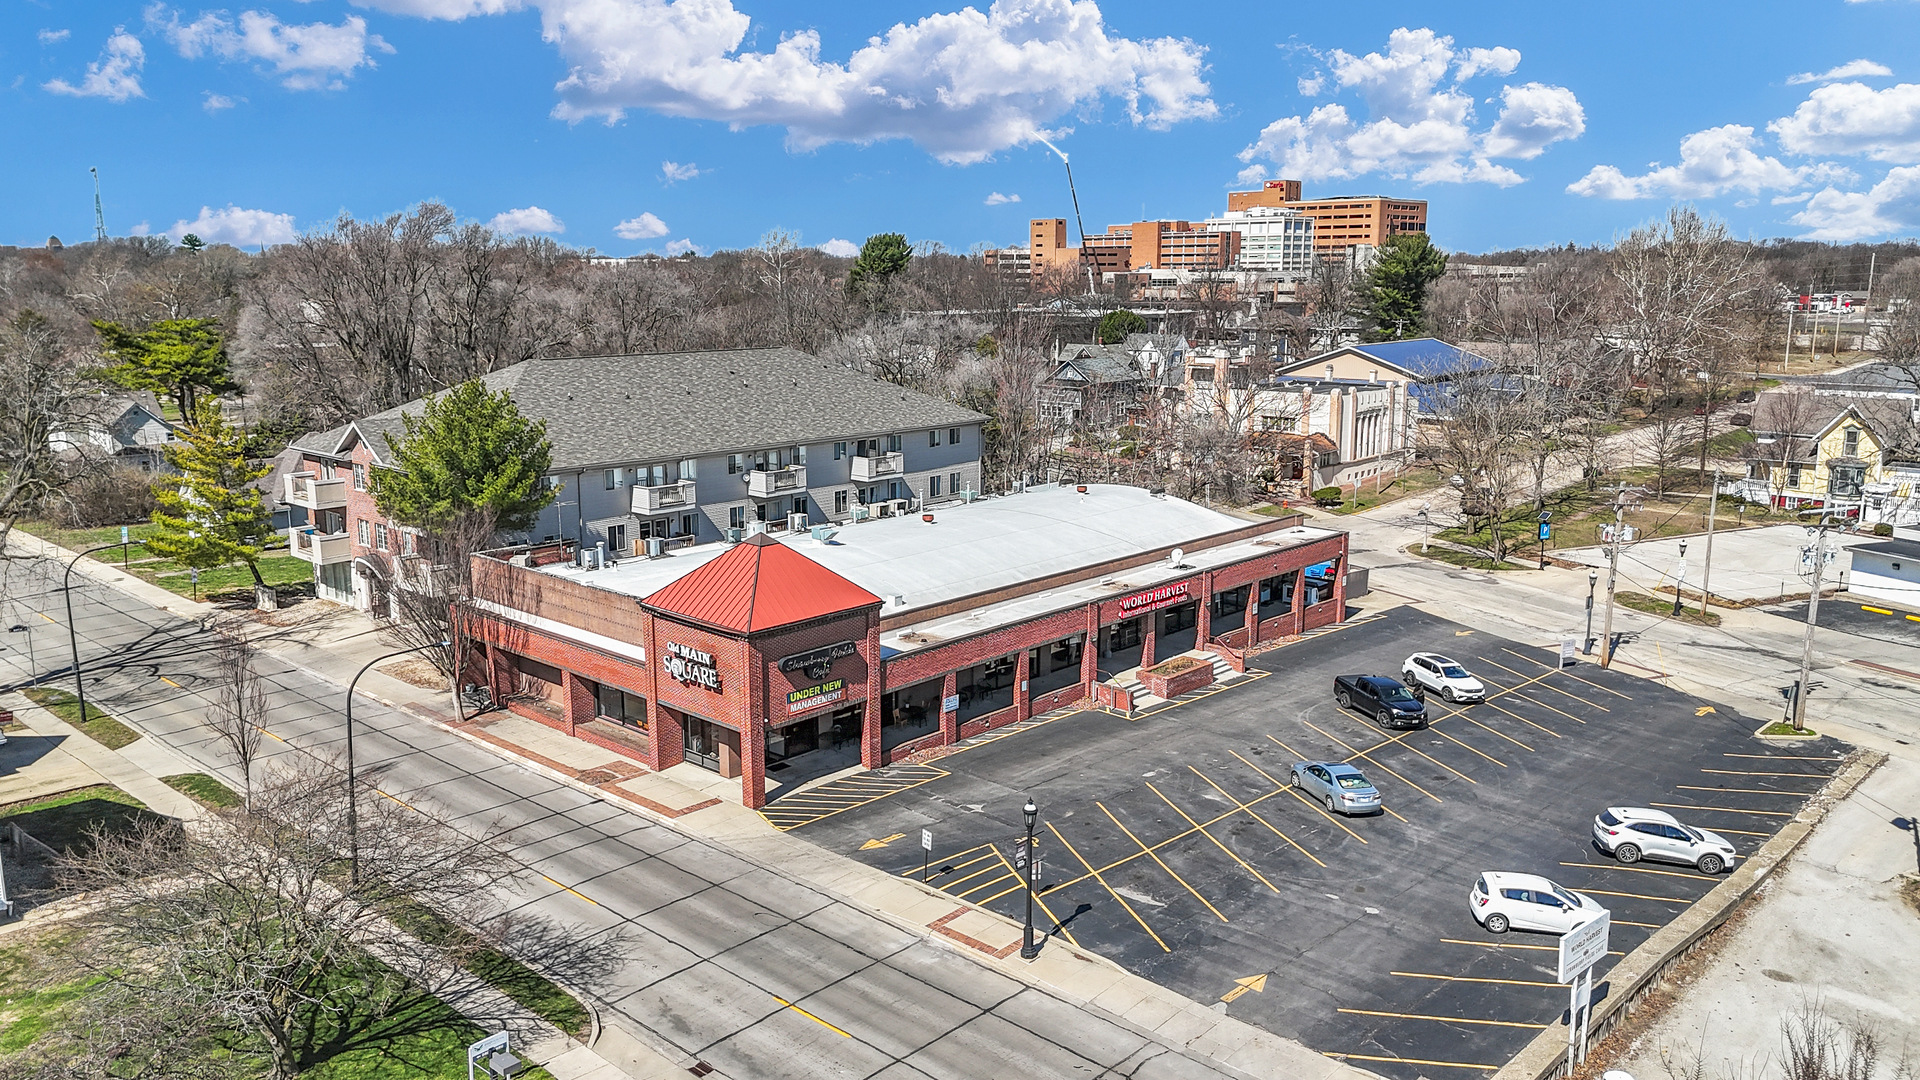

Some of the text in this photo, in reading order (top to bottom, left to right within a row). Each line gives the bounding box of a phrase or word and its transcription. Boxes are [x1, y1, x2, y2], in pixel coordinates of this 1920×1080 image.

[1543, 526, 1548, 534] P
[1122, 582, 1189, 610] WORLD HARVEST
[1122, 604, 1152, 618] International
[1151, 602, 1156, 611] &
[1174, 594, 1188, 604] Foods
[667, 640, 711, 665] Old MAIN
[663, 655, 717, 688] SQUARE
[790, 679, 842, 702] UNDER NEW
[790, 690, 842, 713] MANAGEMENT
